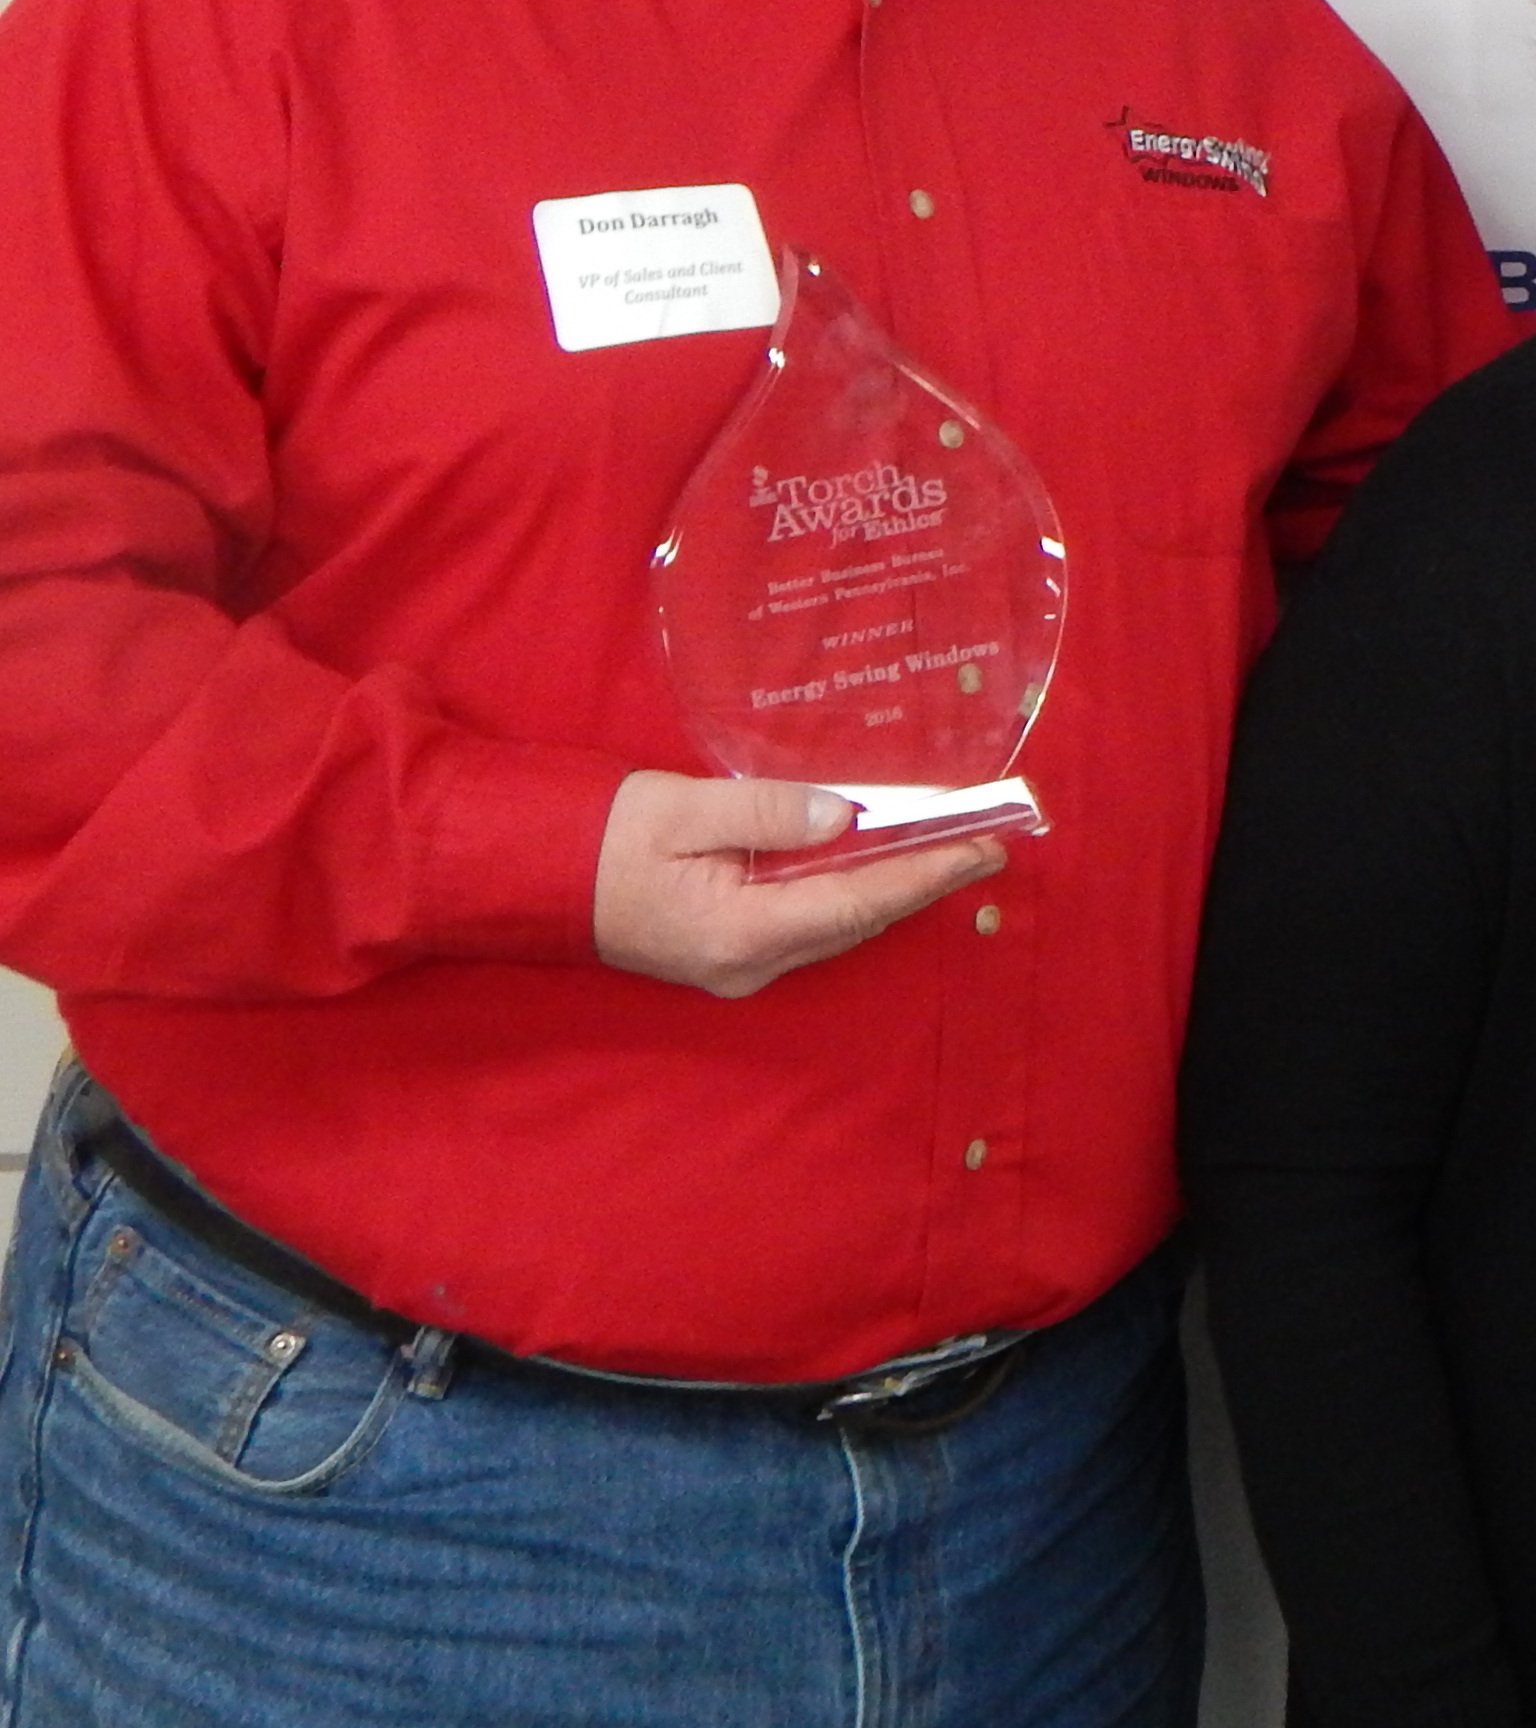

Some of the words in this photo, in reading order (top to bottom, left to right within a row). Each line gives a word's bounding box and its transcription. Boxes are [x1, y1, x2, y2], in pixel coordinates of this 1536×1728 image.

[1129, 129, 1202, 161] Energy
[578, 216, 625, 236] Don
[630, 208, 719, 230] Darragh
[578, 275, 601, 289] VP
[603, 271, 620, 288] of
[623, 267, 665, 285] Sales
[667, 264, 696, 278] and
[699, 261, 744, 277] Client
[624, 284, 709, 304] Consultant
[776, 460, 900, 510] Torch
[767, 475, 948, 543] Awards
[828, 525, 859, 550] for
[863, 509, 948, 543] Ethics
[821, 618, 915, 651] WINNER
[751, 679, 827, 710] Energy
[832, 662, 901, 692] Swing
[904, 641, 1000, 673] Windows
